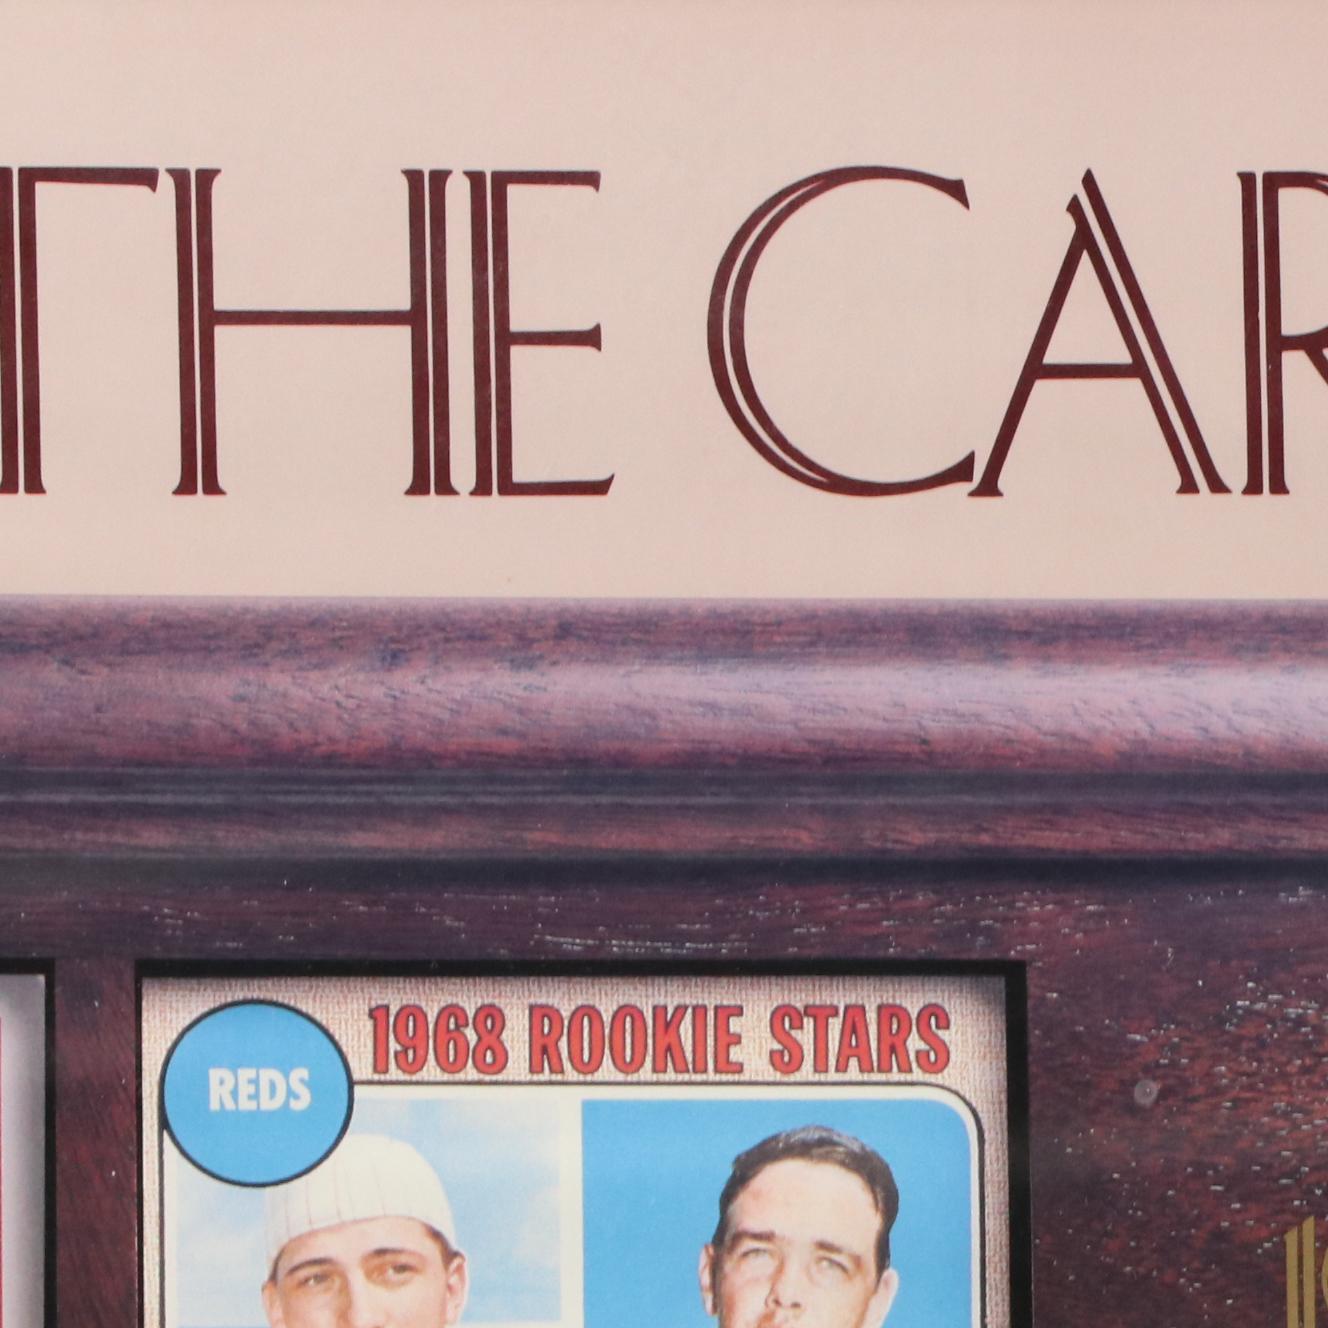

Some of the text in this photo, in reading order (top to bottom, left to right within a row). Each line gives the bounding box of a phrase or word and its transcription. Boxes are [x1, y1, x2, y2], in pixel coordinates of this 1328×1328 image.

[0, 166, 614, 496] THE
[368, 1002, 952, 1076] 1968 ROOKIE STARS
[208, 1066, 312, 1113] REDS
